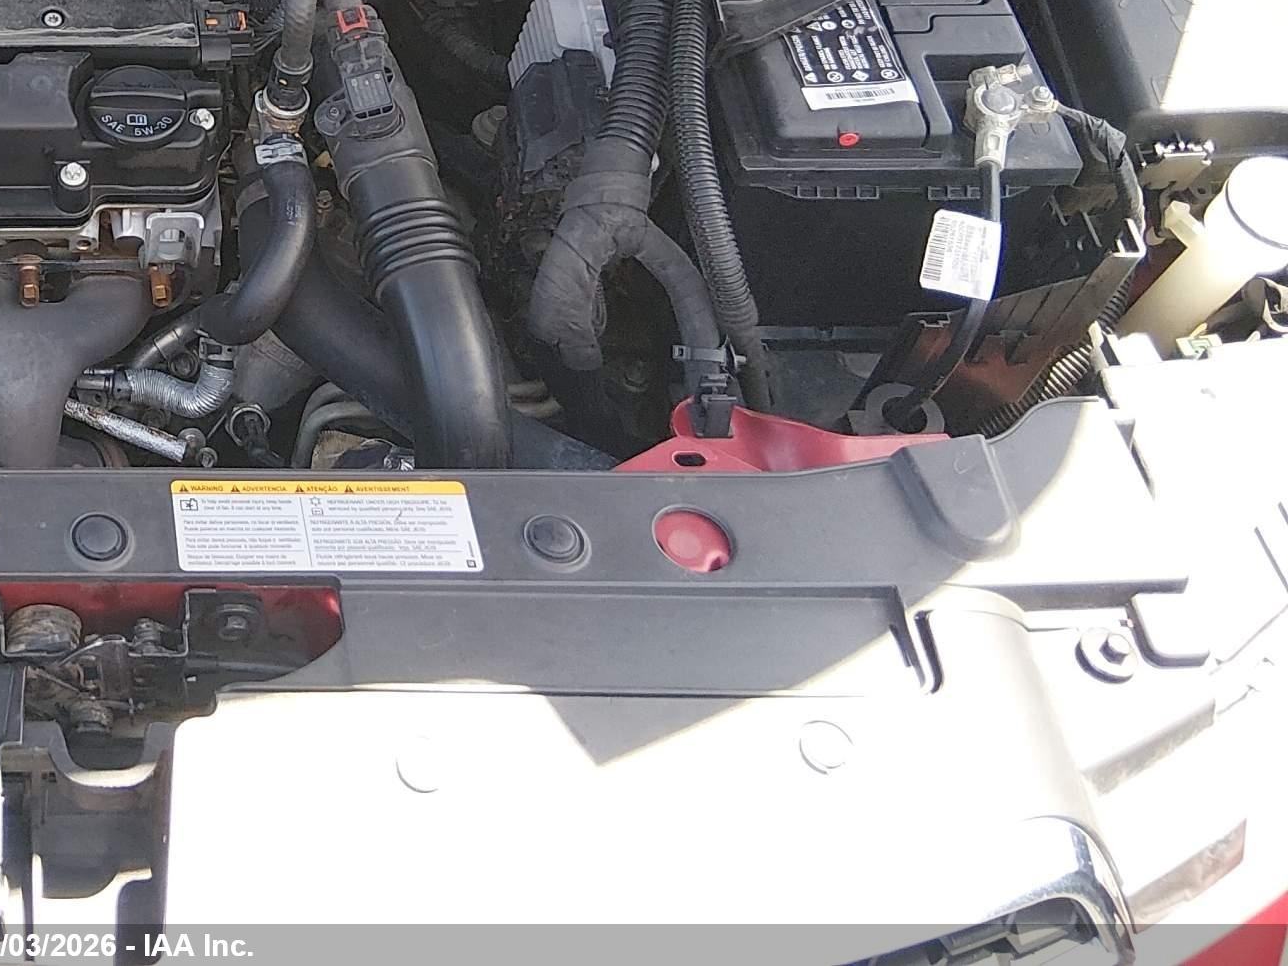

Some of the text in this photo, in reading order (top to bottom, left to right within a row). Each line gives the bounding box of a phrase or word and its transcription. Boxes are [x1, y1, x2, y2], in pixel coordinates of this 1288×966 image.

[101, 115, 126, 134] SAE
[190, 485, 224, 493] WARNING
[241, 485, 288, 493] ADVERTENCIA
[305, 485, 339, 495] ATENÇÃO
